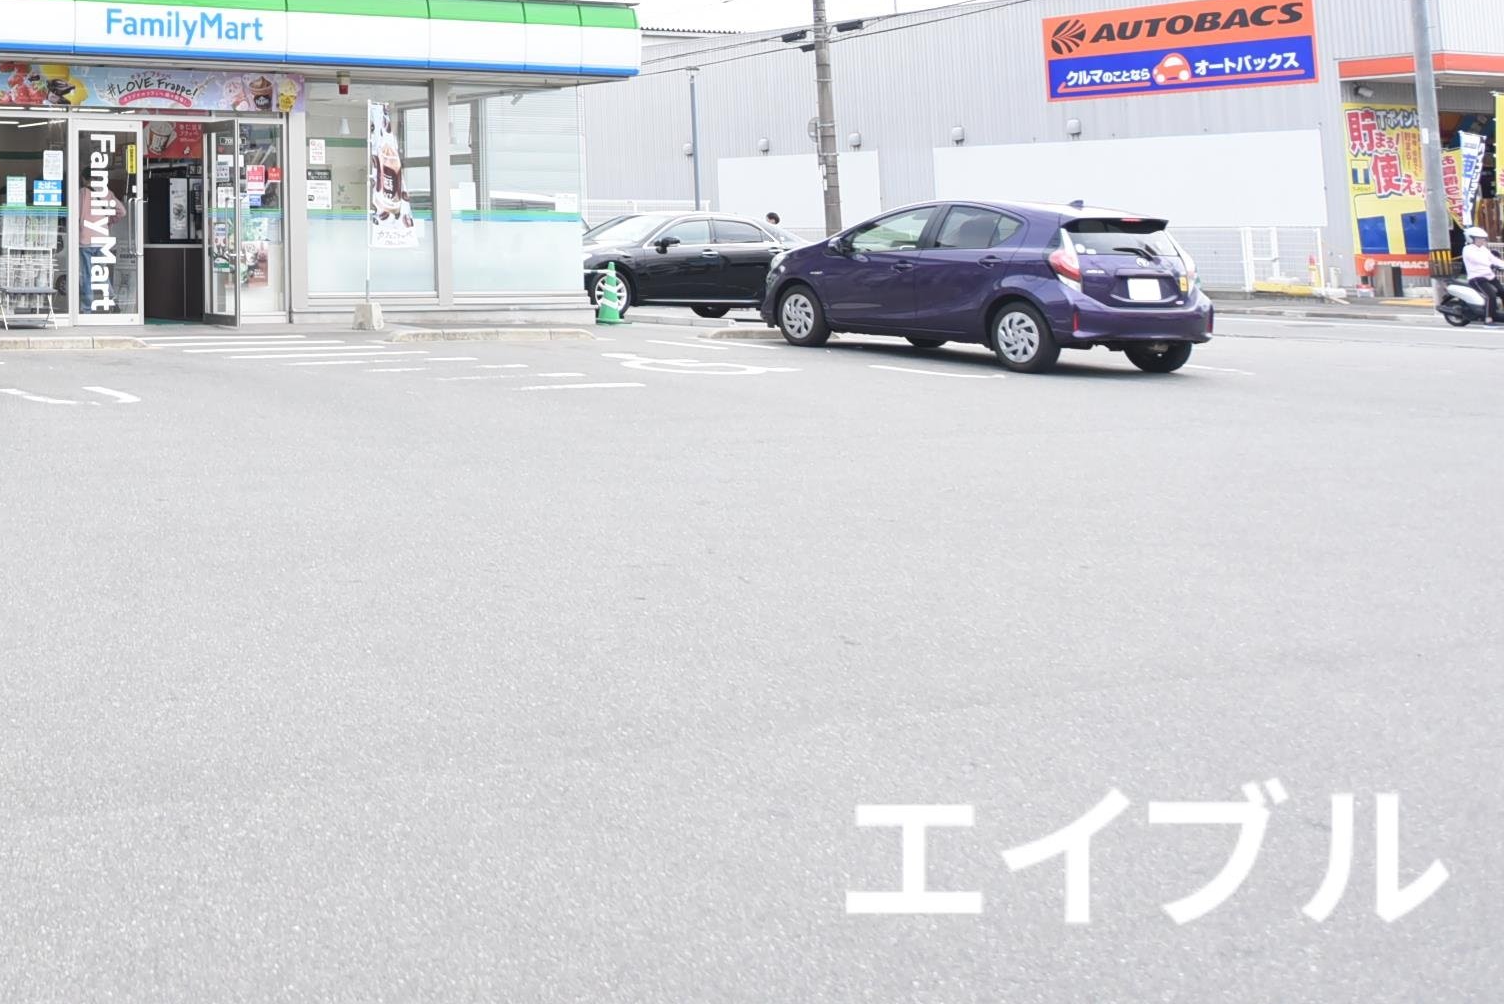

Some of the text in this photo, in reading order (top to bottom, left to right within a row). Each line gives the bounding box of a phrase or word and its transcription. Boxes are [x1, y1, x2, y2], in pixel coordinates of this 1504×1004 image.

[106, 8, 264, 46] FamilyMart
[1089, 2, 1304, 44] AUTOBACS
[1065, 52, 1299, 87] クルマのことなら オートバックス
[85, 134, 117, 312] FamilyMart
